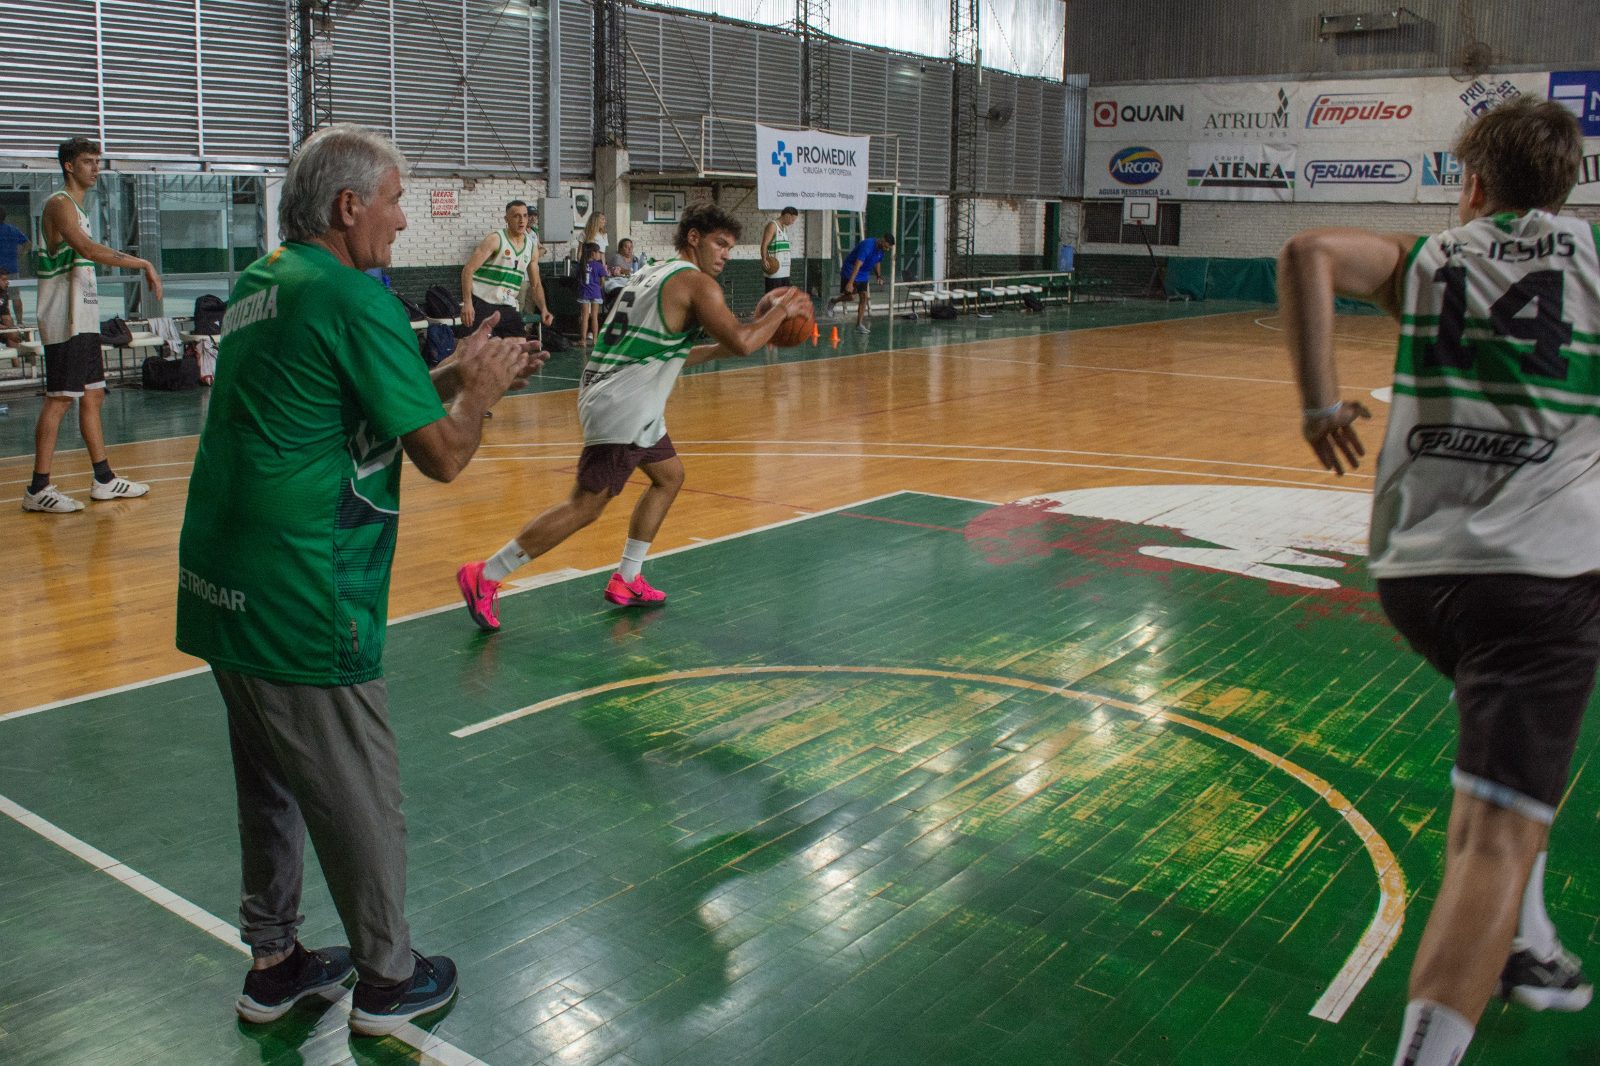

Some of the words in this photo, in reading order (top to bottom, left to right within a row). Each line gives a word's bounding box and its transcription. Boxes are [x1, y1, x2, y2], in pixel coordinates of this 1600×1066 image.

[1459, 81, 1486, 106] PRO
[1121, 104, 1184, 122] QUAIN
[1203, 112, 1291, 129] ATRIUM
[1312, 98, 1412, 125] impulso
[797, 146, 856, 167] PROMEDIK
[1111, 159, 1161, 174] ARCOR
[1205, 162, 1285, 179] ATENEA
[603, 290, 636, 347] 6
[1423, 263, 1574, 380] 14
[180, 566, 247, 613] ETROGAR
